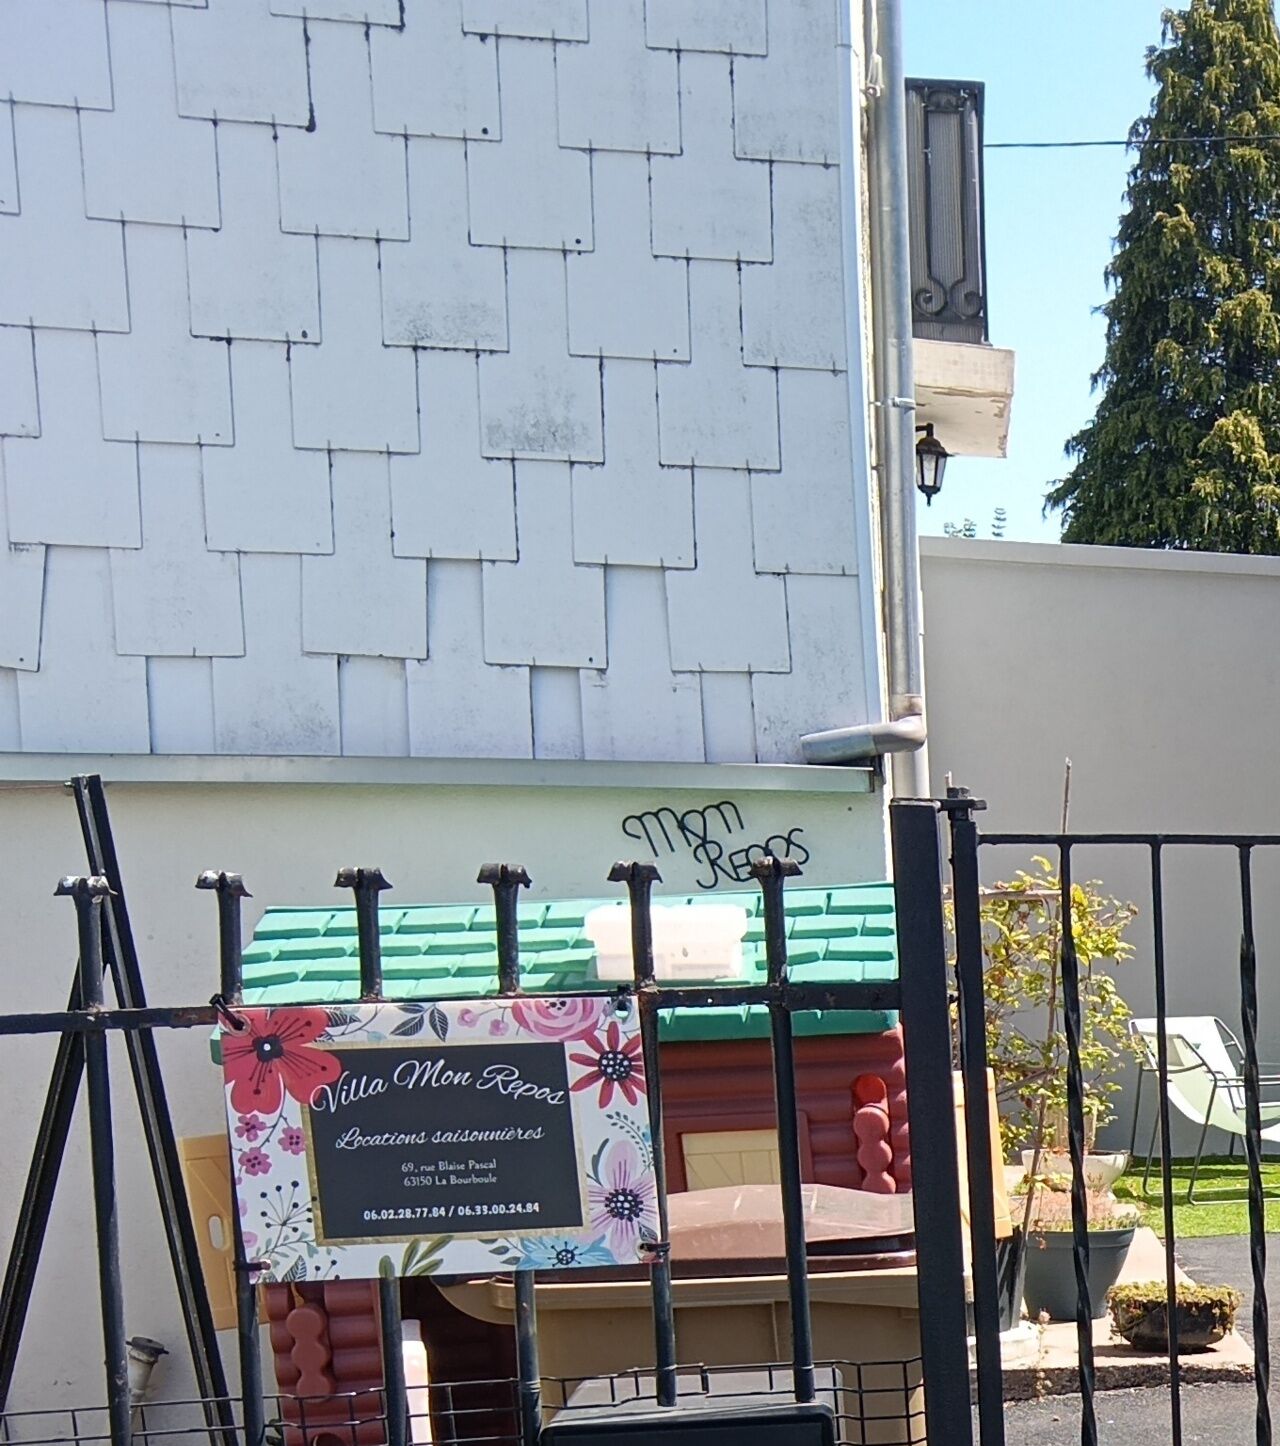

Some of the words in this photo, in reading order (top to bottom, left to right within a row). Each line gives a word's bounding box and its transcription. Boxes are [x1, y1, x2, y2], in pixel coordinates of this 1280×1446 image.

[310, 1070, 388, 1113] Villa
[393, 1058, 472, 1090] Mon
[476, 1064, 565, 1105] Repos
[335, 1126, 429, 1150] Locations
[431, 1126, 545, 1143] saisonnières
[420, 1164, 436, 1172] rue
[438, 1160, 466, 1171] Blaise
[468, 1158, 497, 1170] Pascal
[403, 1176, 433, 1187] 63150
[435, 1175, 447, 1185] La
[450, 1173, 497, 1185] Bourboule
[448, 1205, 455, 1217] /
